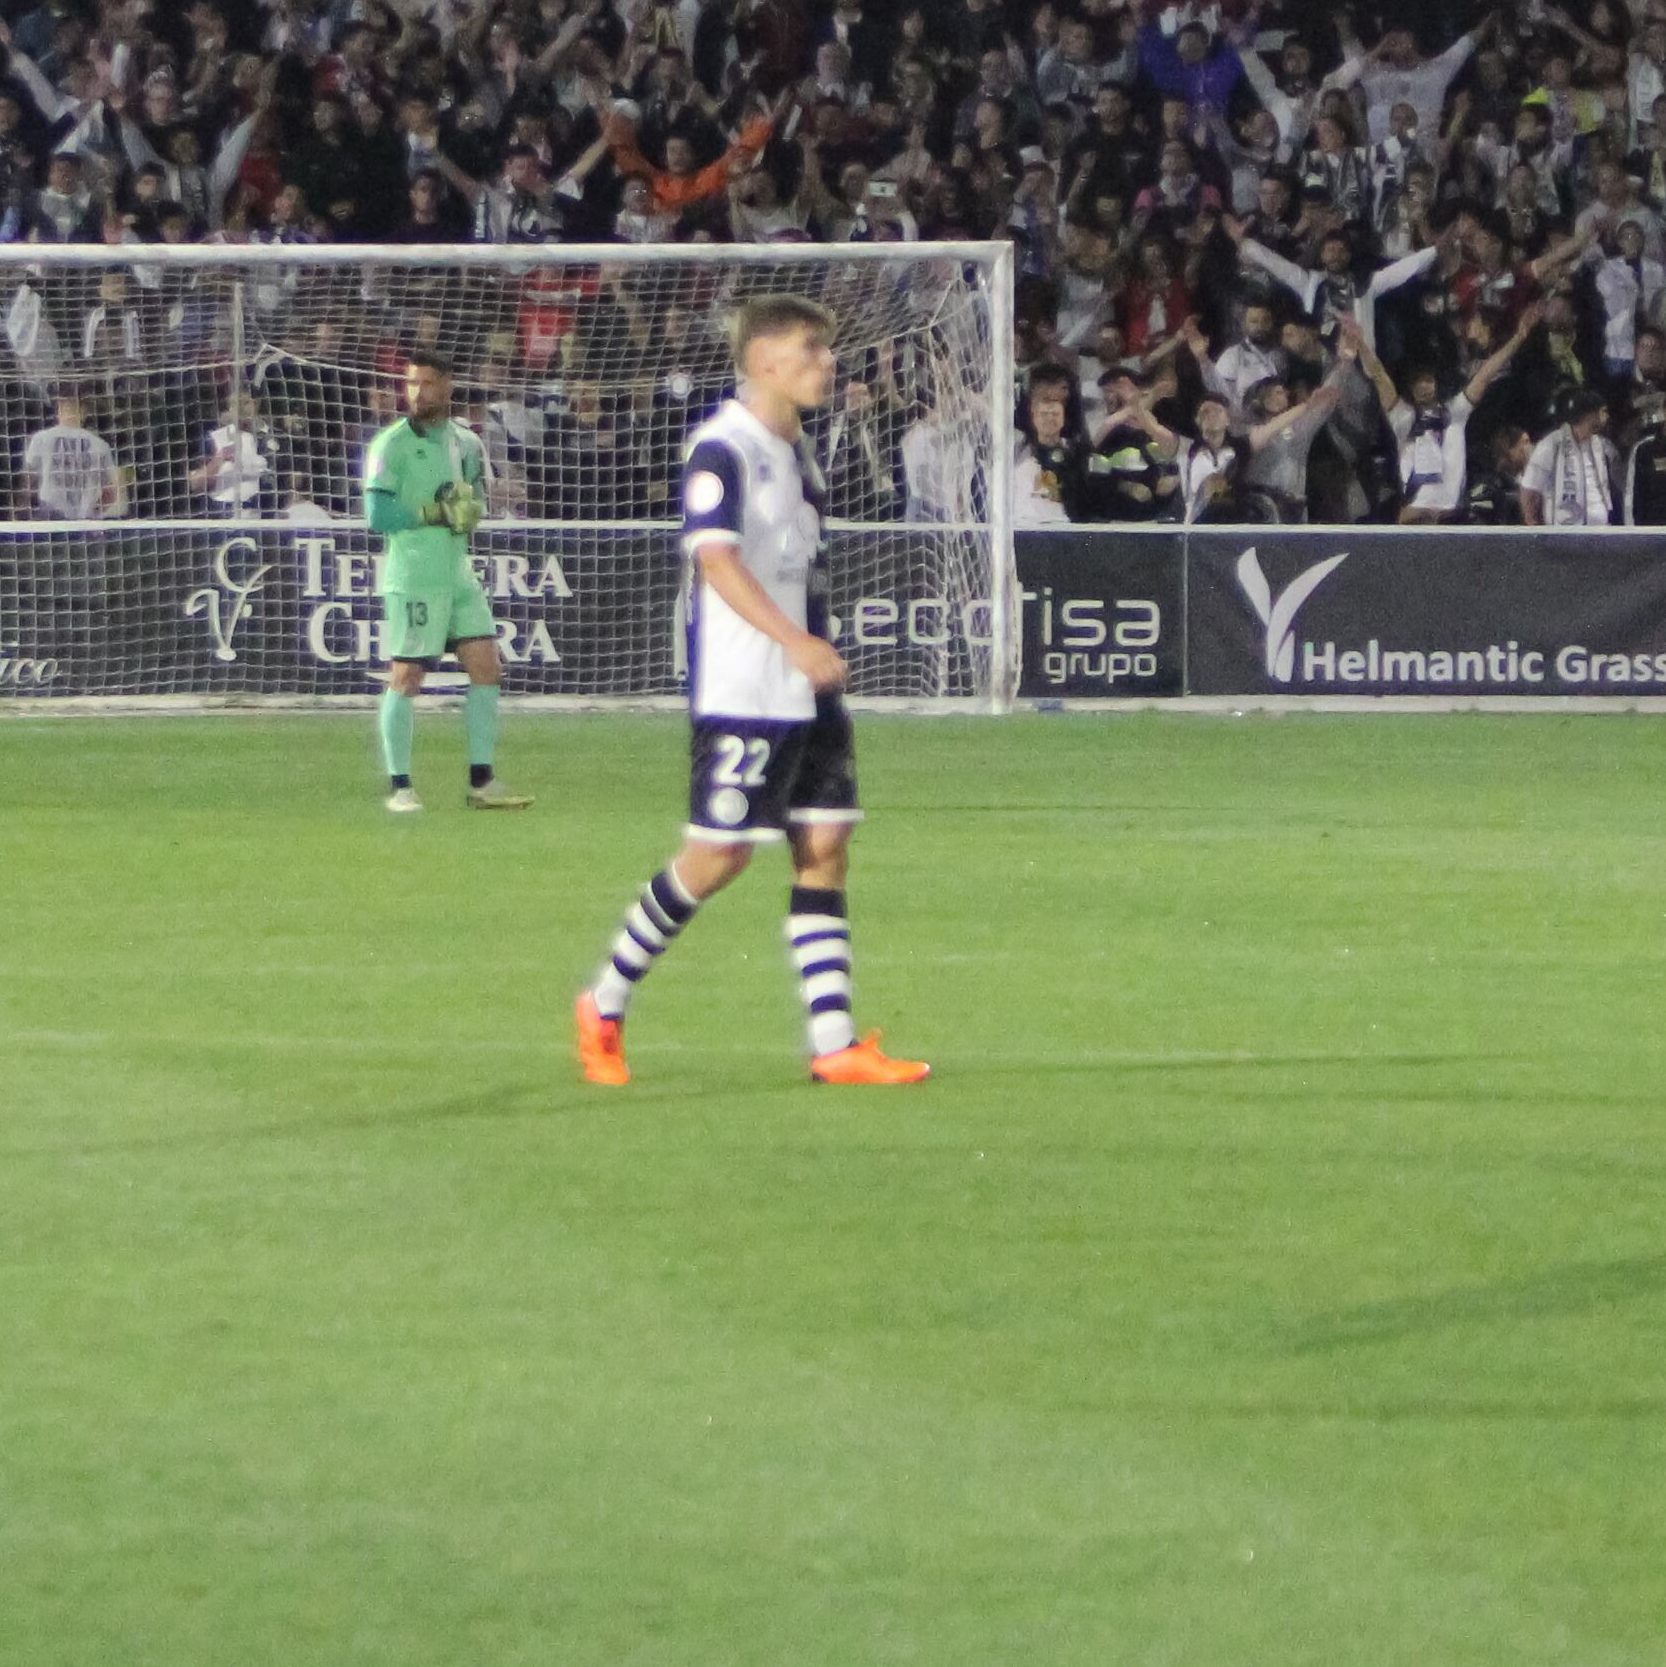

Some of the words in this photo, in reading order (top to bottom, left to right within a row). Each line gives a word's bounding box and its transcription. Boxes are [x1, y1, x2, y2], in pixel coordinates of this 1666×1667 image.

[405, 600, 430, 628] 13
[1044, 652, 1158, 685] grupo
[1302, 639, 1545, 684] Helmantic
[713, 734, 771, 787] 22
